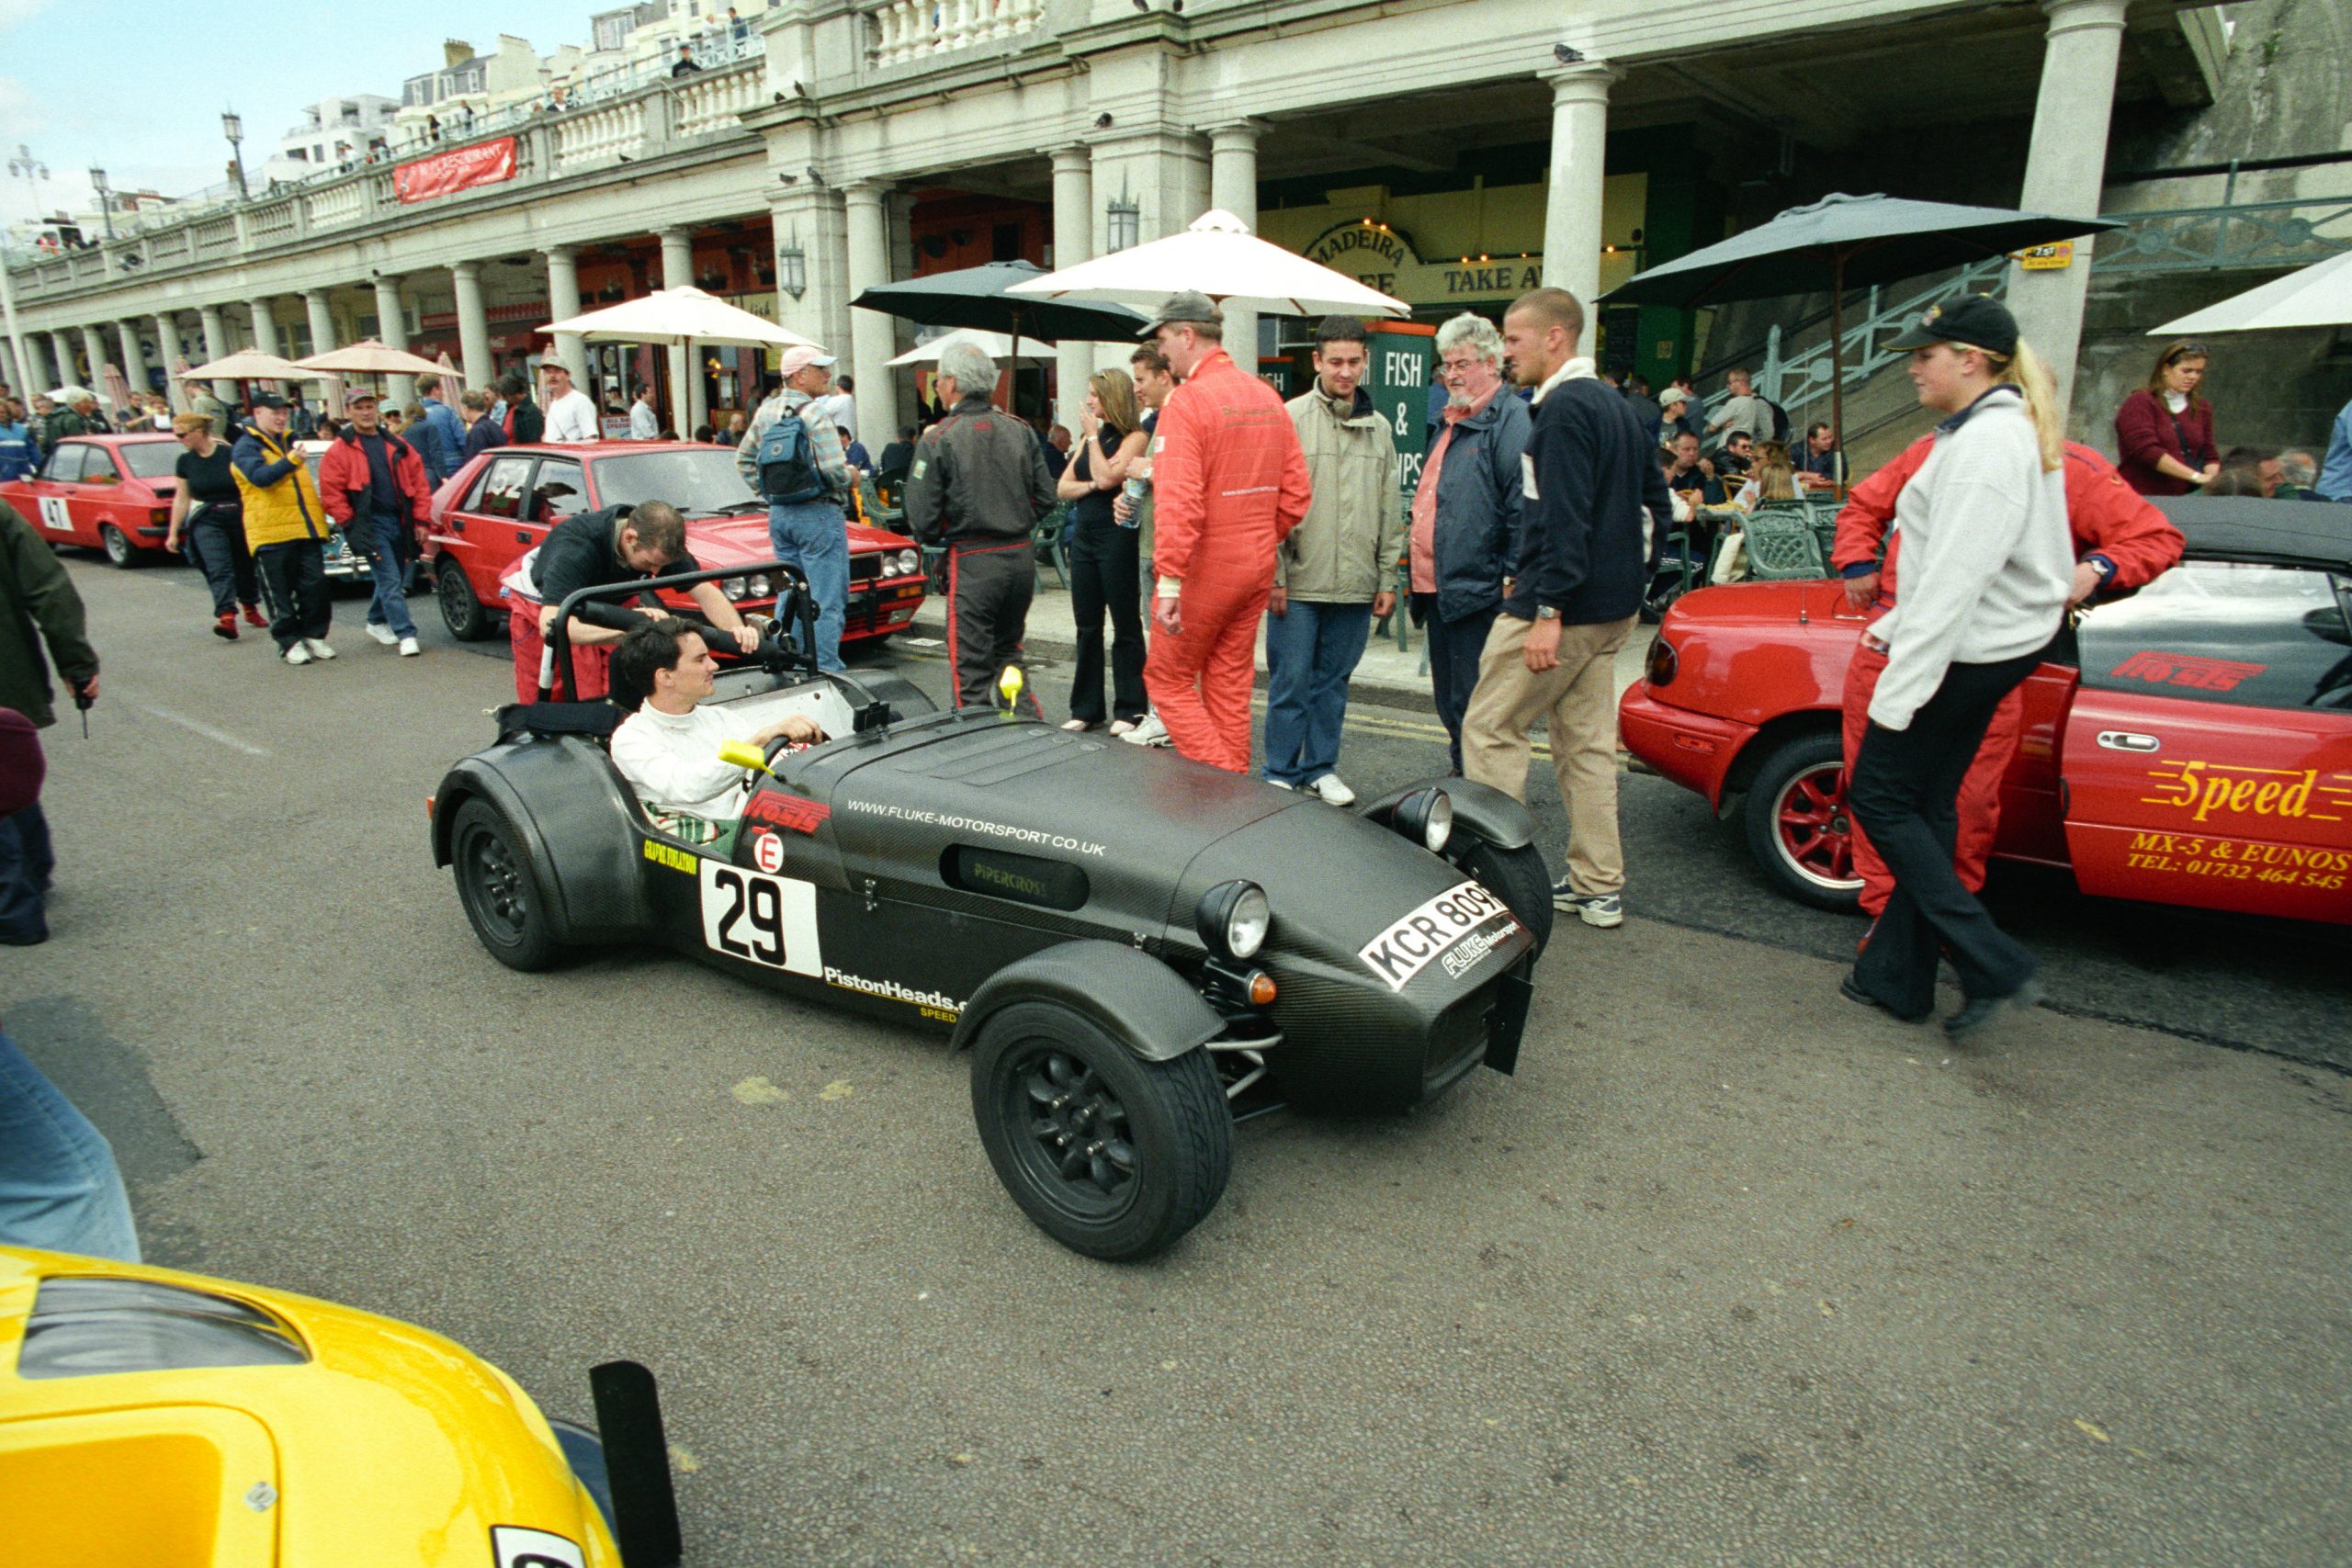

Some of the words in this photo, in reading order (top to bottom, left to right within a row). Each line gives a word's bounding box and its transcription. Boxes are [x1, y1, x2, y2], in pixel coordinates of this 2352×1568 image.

[1311, 230, 1404, 268] MADEIRA
[1444, 267, 1512, 294] TAKE
[1385, 352, 1422, 387] FISH
[1396, 402, 1408, 435] &
[1398, 453, 1423, 485] IPS
[847, 799, 1051, 844] WWW.FLUKE-MOTORSPORT
[761, 836, 778, 870] E
[2131, 832, 2205, 855] MX-5
[2210, 841, 2233, 859] &
[2240, 844, 2352, 871] EUNOS
[2127, 853, 2181, 871] TEL:
[2187, 860, 2251, 879] 01732
[2256, 868, 2297, 884] 464
[2301, 873, 2346, 889] 545
[715, 868, 786, 966] 29
[1367, 916, 1453, 982] KCR
[1442, 933, 1488, 976] FLUKE
[1483, 919, 1521, 946] Motorsport
[824, 966, 967, 1012] PistonHeads.c
[921, 1008, 956, 1023] SPEED
